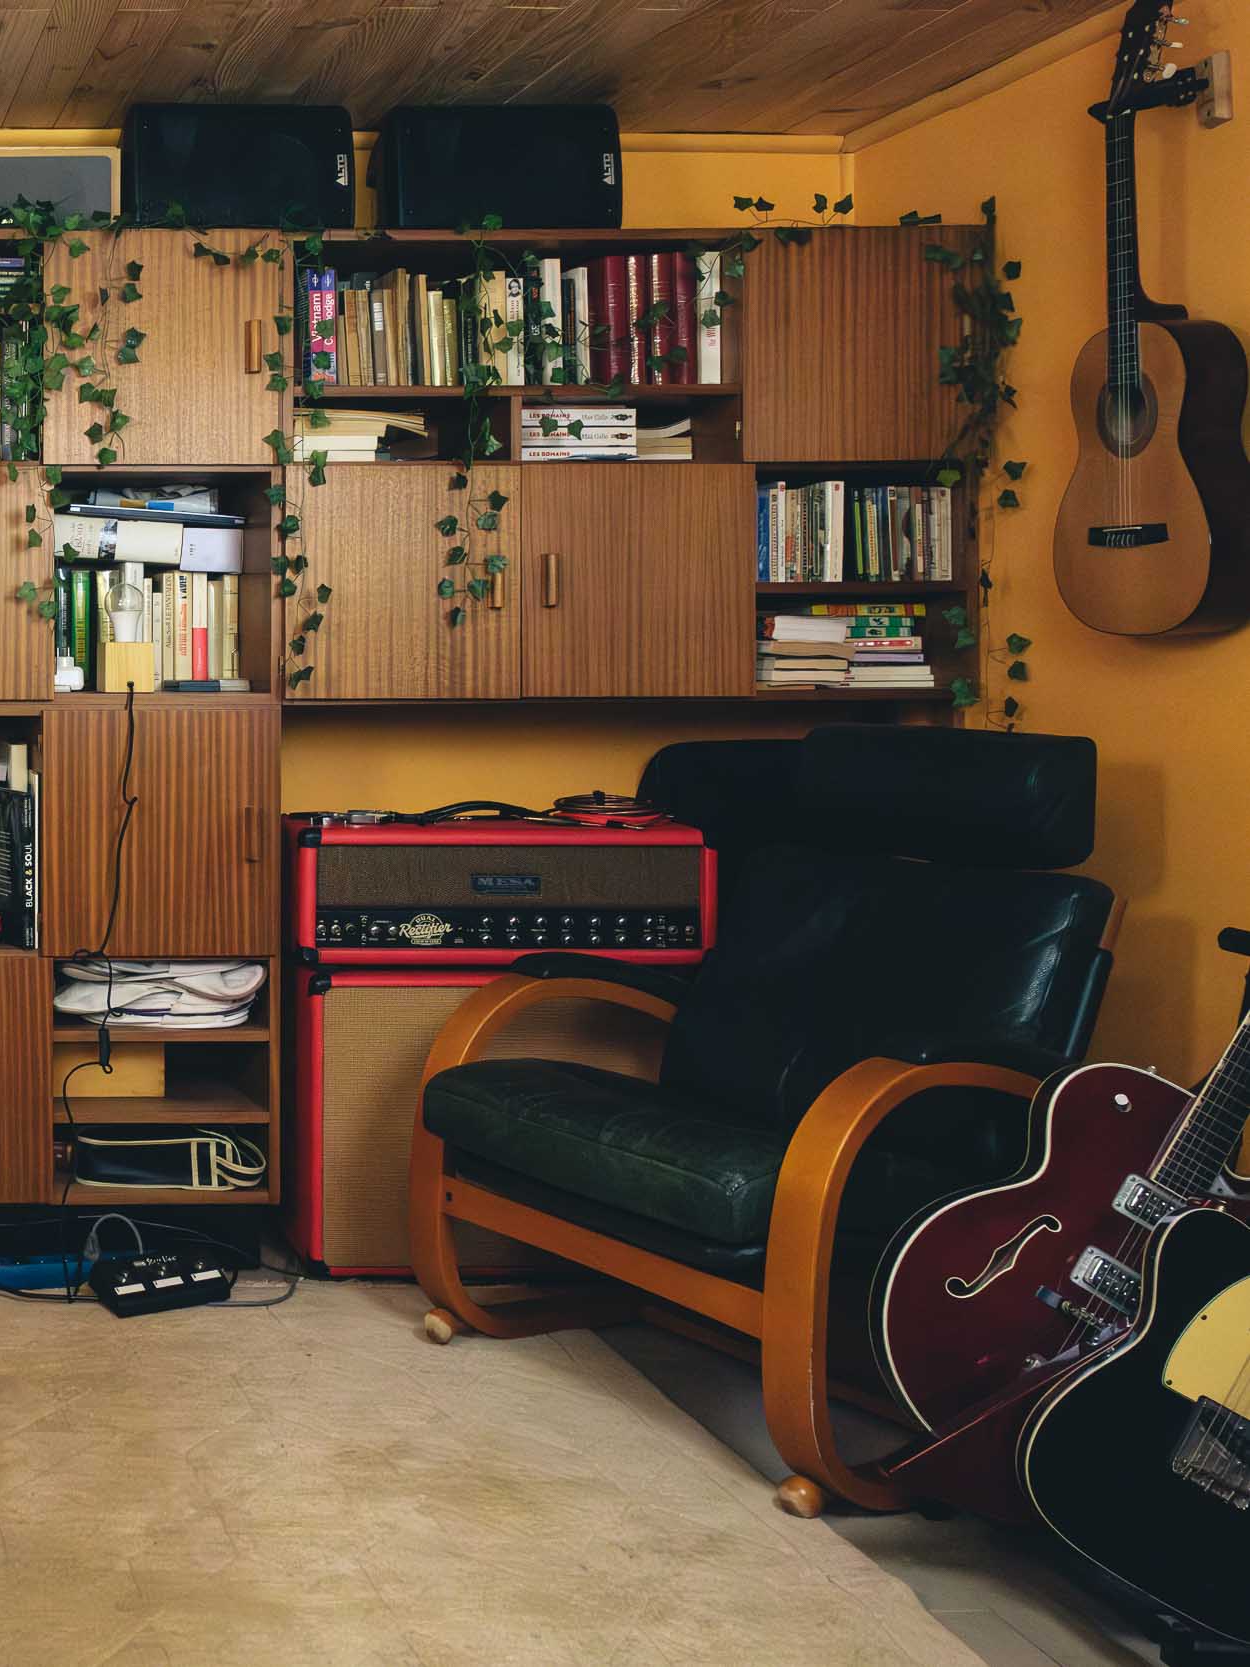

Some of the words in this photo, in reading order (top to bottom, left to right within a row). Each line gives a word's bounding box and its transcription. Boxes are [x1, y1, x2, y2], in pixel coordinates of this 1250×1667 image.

[335, 153, 348, 186] ALTO
[602, 153, 614, 185] ALTO
[24, 842, 32, 867] SOUL
[24, 868, 32, 876] &
[24, 877, 33, 908] BLACK
[398, 922, 454, 938] Rectifier
[414, 914, 437, 924] DUAL
